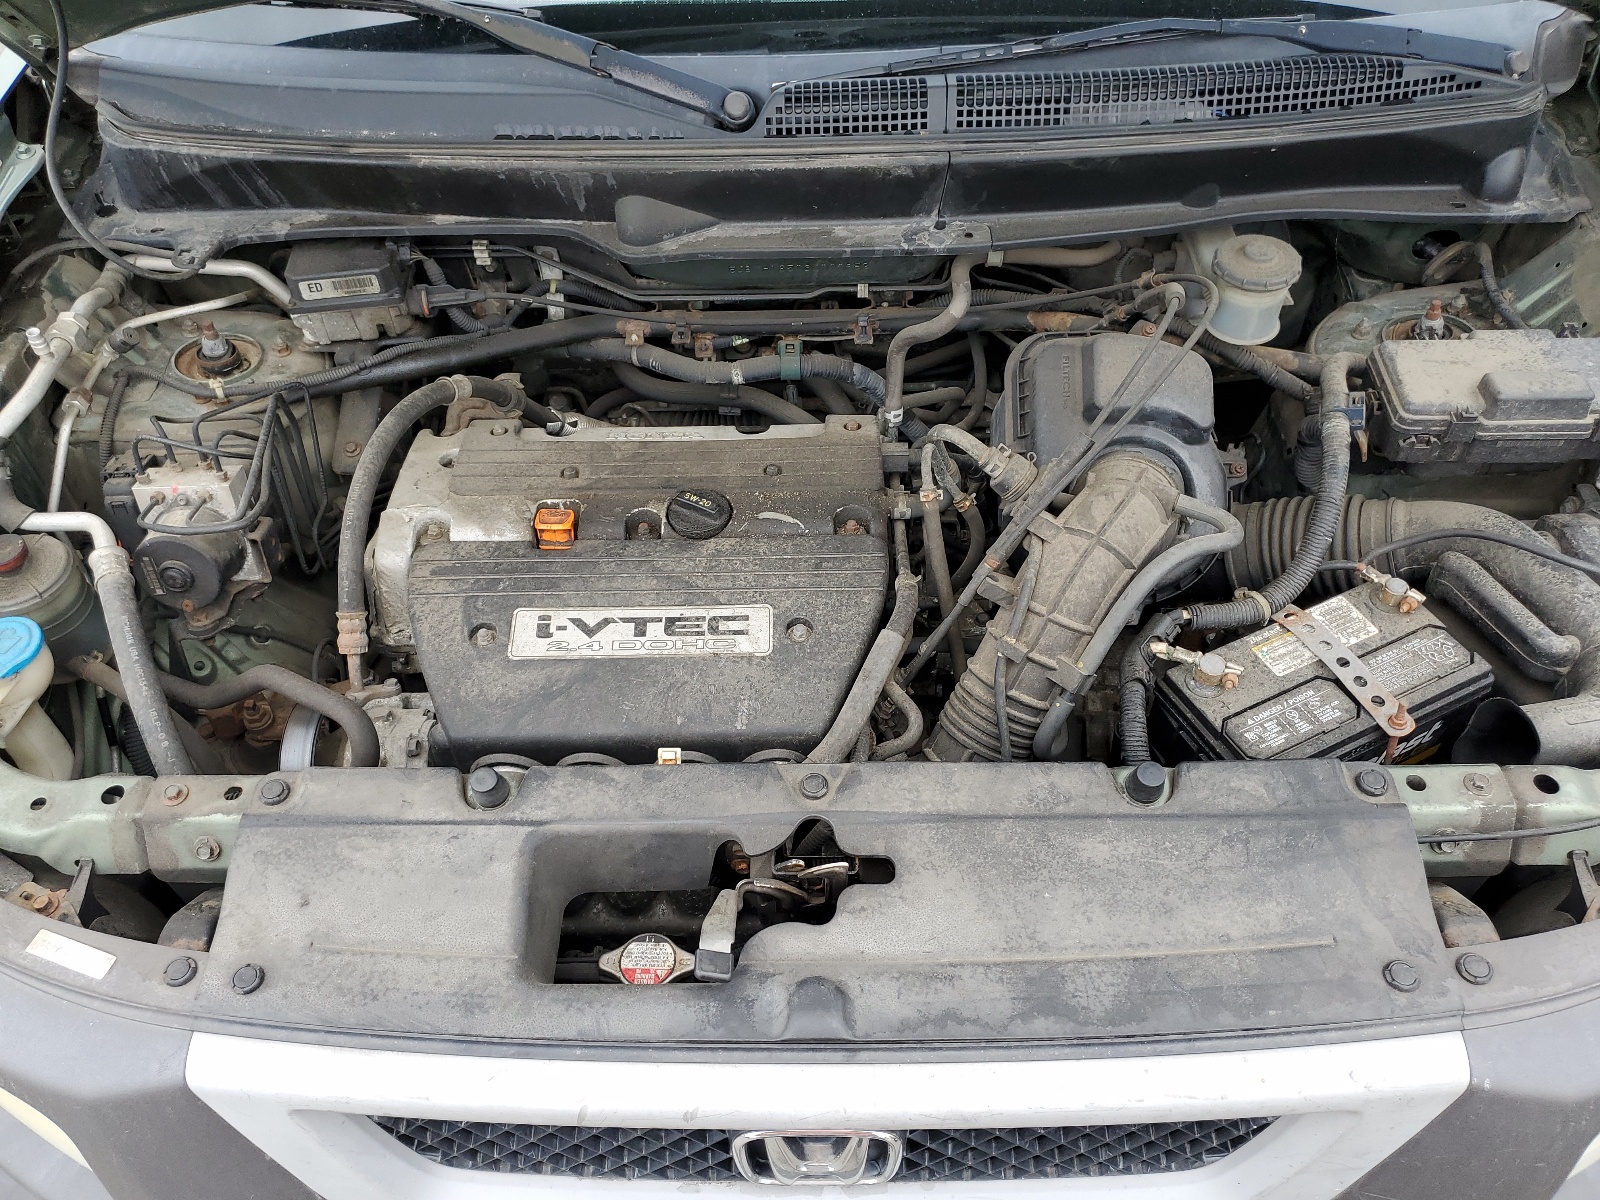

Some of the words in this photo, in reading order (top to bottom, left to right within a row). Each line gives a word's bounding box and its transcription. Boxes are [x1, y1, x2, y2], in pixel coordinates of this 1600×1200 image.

[307, 282, 323, 293] ED
[683, 492, 712, 507] 5W-20
[535, 614, 751, 640] i-VTEC
[546, 640, 605, 652] 2.4
[611, 638, 738, 651] DOHC
[1253, 704, 1284, 722] DANGER
[1288, 689, 1316, 707] POISON
